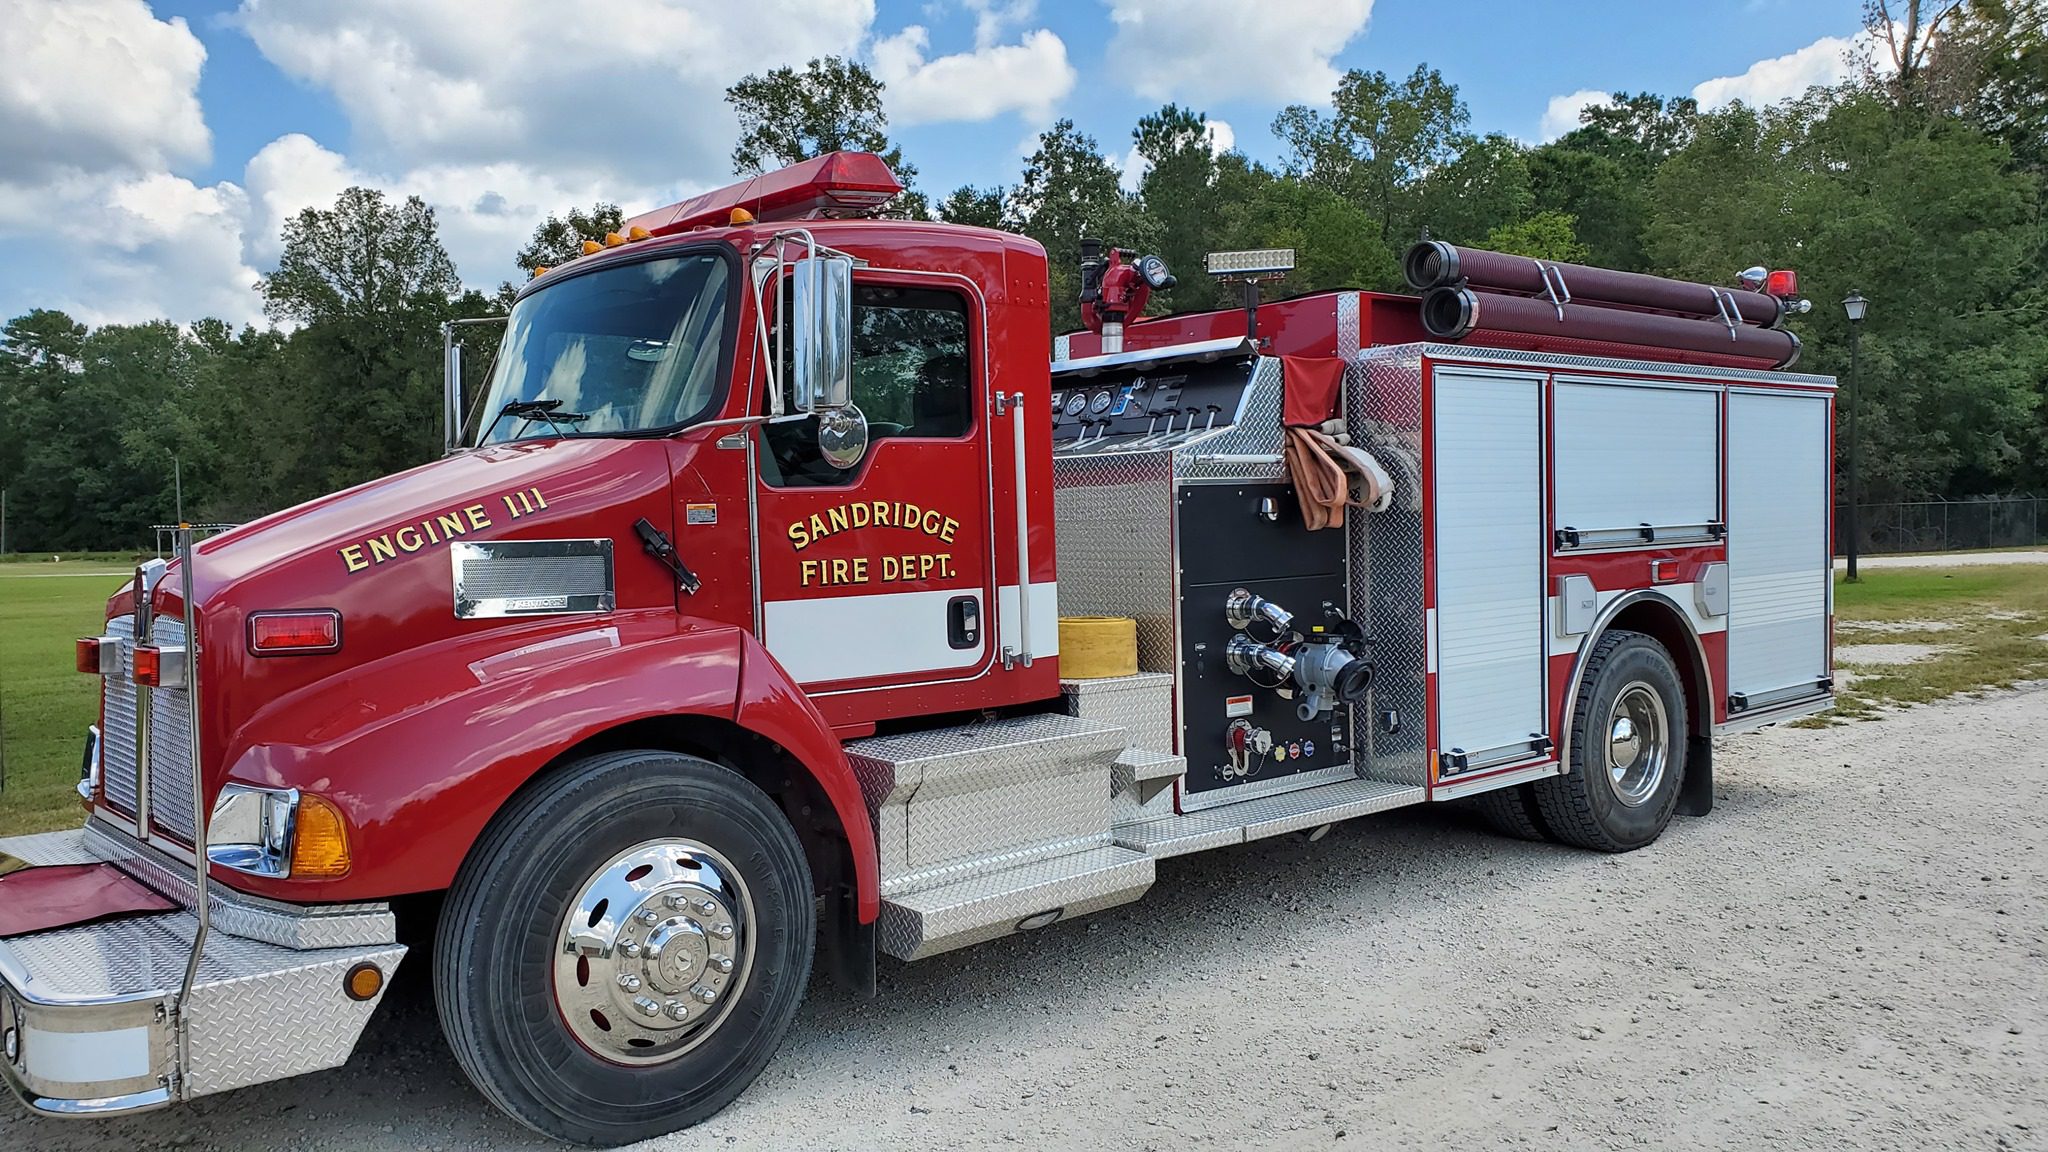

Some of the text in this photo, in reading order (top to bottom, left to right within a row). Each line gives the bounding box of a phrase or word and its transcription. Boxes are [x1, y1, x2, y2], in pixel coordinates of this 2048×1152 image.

[338, 487, 549, 574] ENGINE III
[787, 500, 960, 550] SANDRIDGE
[801, 553, 957, 586] FIRE DEPT.
[519, 872, 575, 1073] MICHELIN
